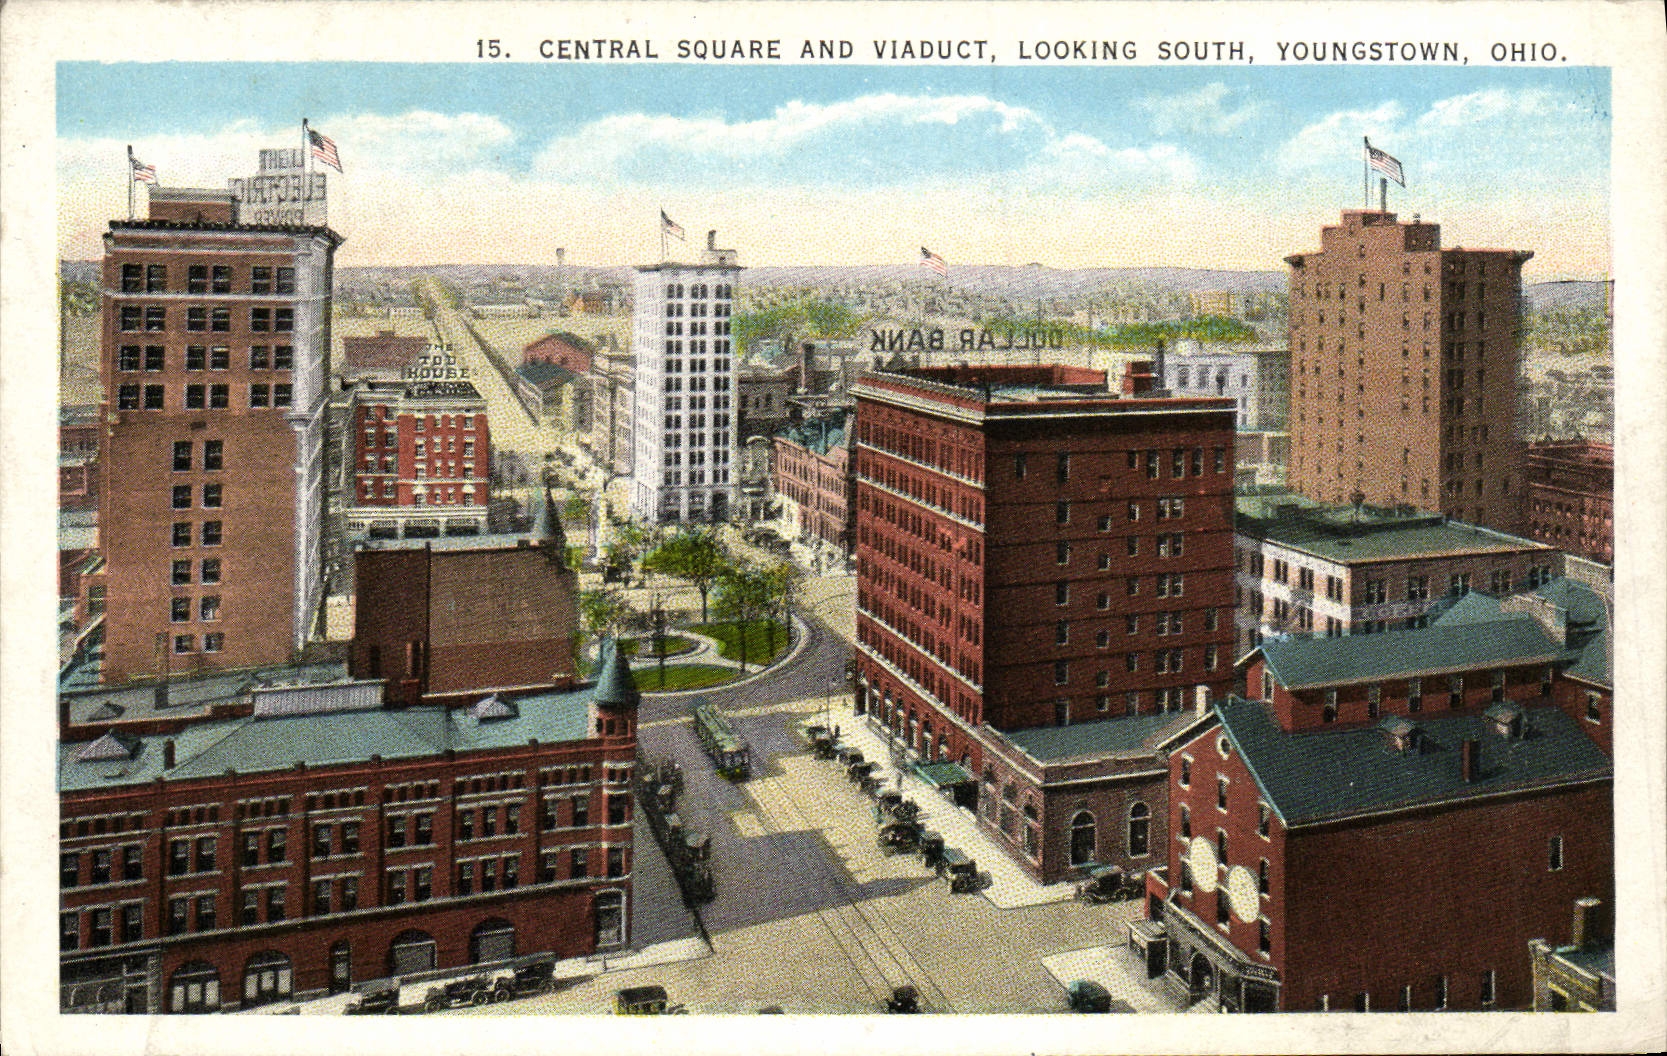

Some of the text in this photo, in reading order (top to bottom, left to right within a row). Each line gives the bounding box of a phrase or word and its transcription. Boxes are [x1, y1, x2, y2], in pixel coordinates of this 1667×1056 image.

[425, 343, 453, 352] THE
[418, 355, 457, 366] TOD
[407, 367, 471, 379] HOUSE
